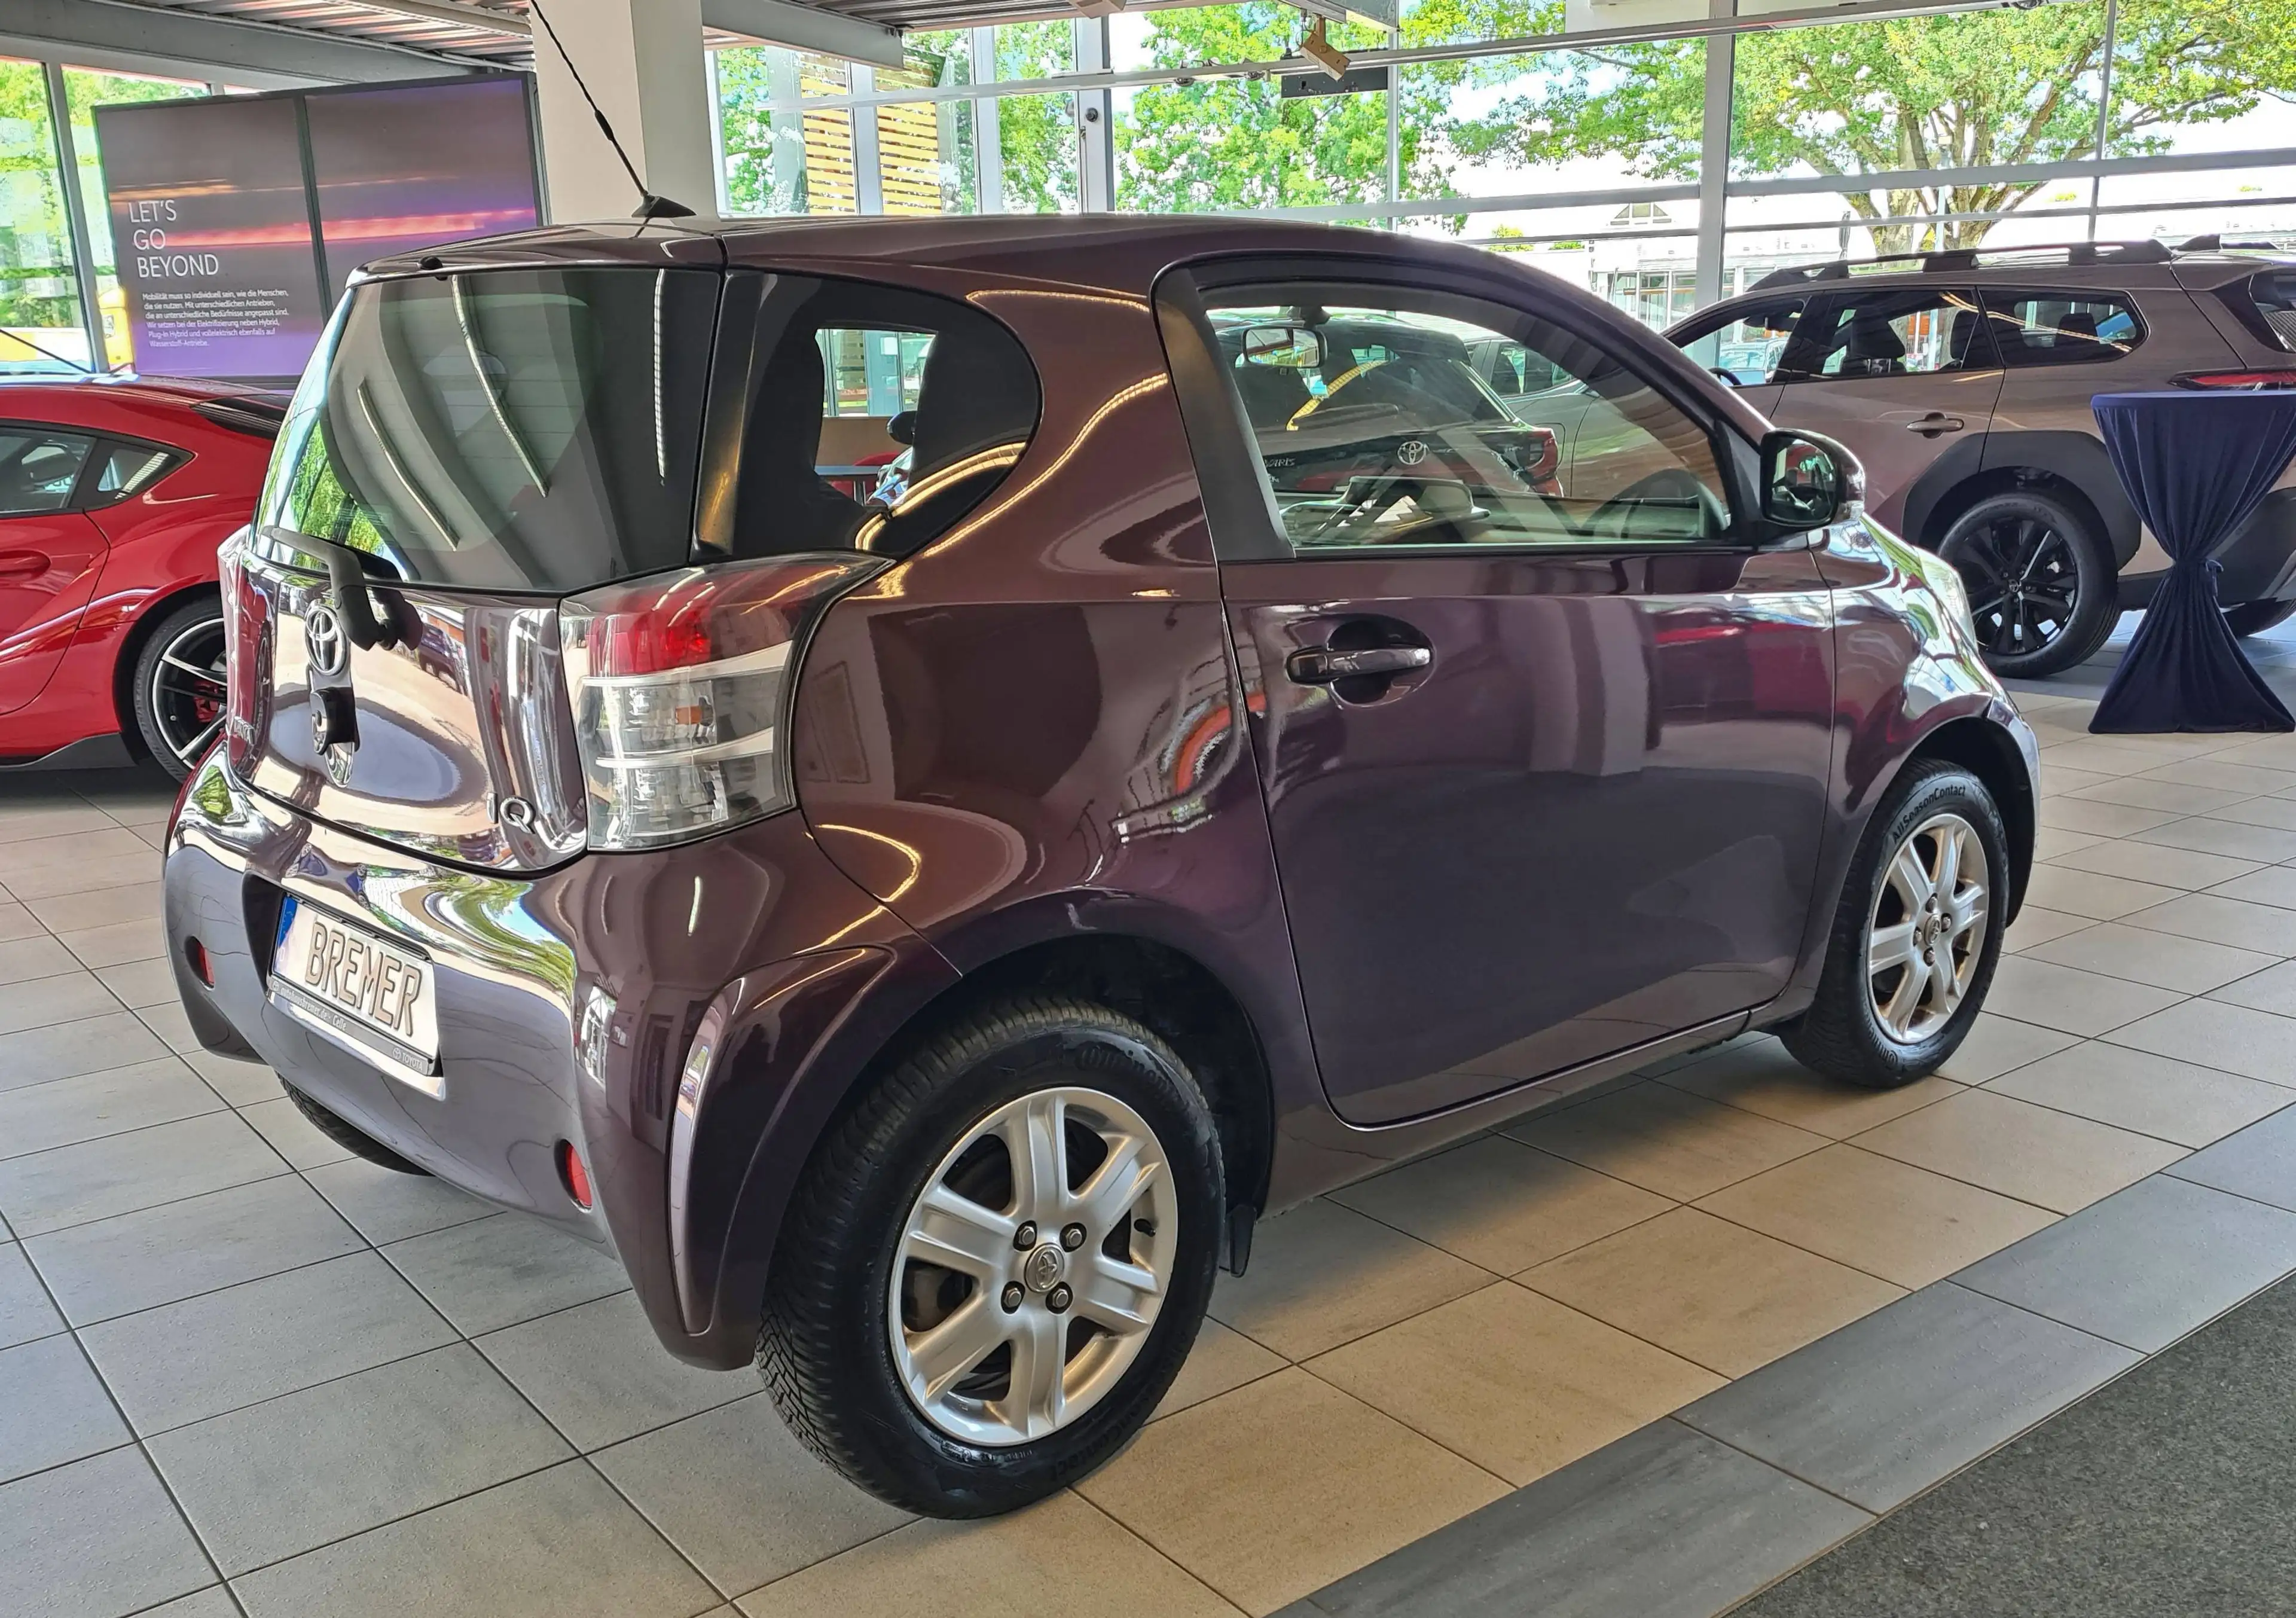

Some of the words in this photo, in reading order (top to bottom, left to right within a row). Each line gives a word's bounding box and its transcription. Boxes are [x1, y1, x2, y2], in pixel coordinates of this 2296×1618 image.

[128, 199, 177, 222] LET'S
[133, 228, 166, 250] GO
[137, 254, 218, 277] BEYOND
[192, 291, 221, 299] individuell
[257, 289, 289, 297] Menschen,
[195, 300, 245, 309] unterschiedlichen
[164, 310, 209, 319] unterschiedliche
[244, 310, 275, 318] angepasst
[258, 318, 280, 327] Hybrid,
[169, 330, 189, 339] Hybrid
[1892, 784, 1965, 845] AllSeasonContact
[306, 921, 422, 1037] BREMER
[332, 1014, 347, 1031] Celle
[402, 1052, 423, 1071] TOYOTA
